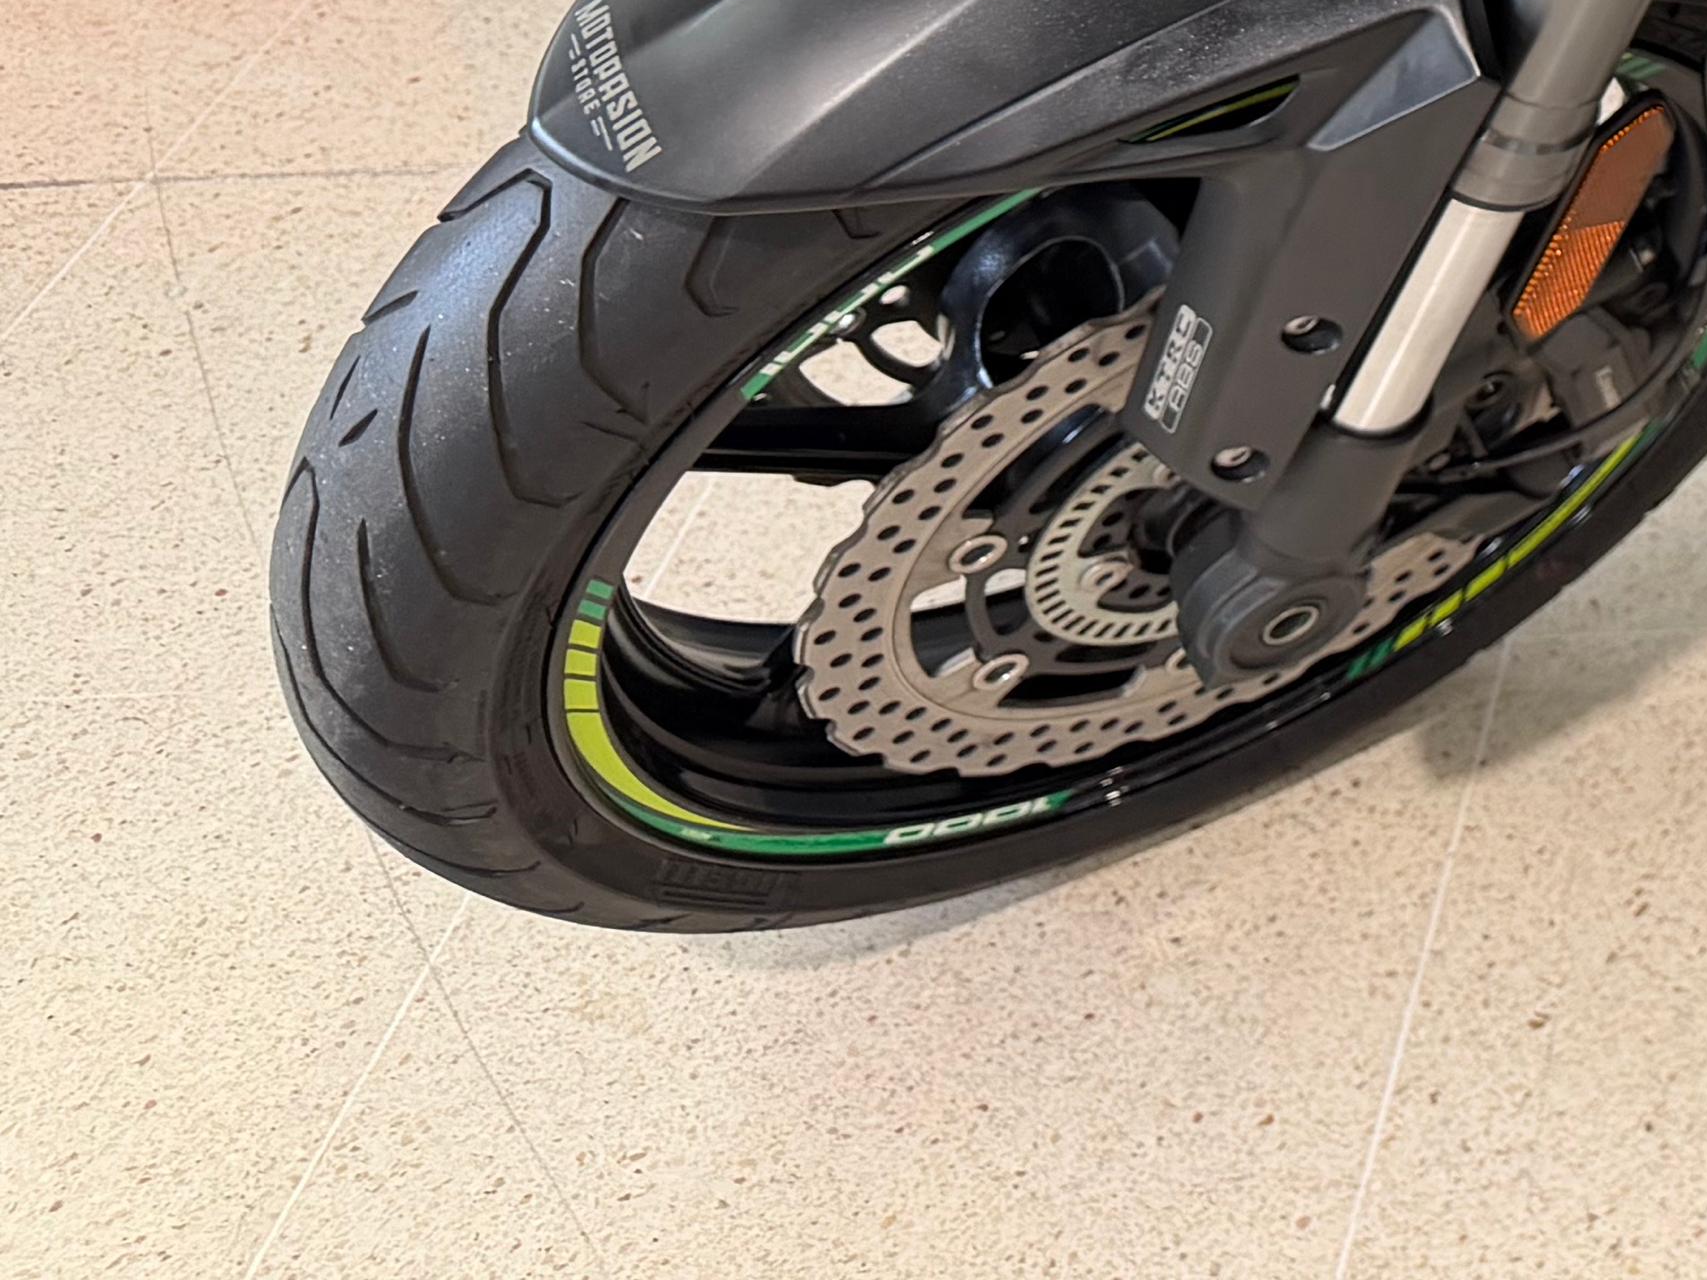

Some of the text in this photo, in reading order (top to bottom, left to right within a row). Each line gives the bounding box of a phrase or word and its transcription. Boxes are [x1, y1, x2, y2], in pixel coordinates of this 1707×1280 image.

[570, 56, 602, 115] STORE
[1147, 311, 1193, 412] KTRC
[1168, 339, 1204, 412] ABS
